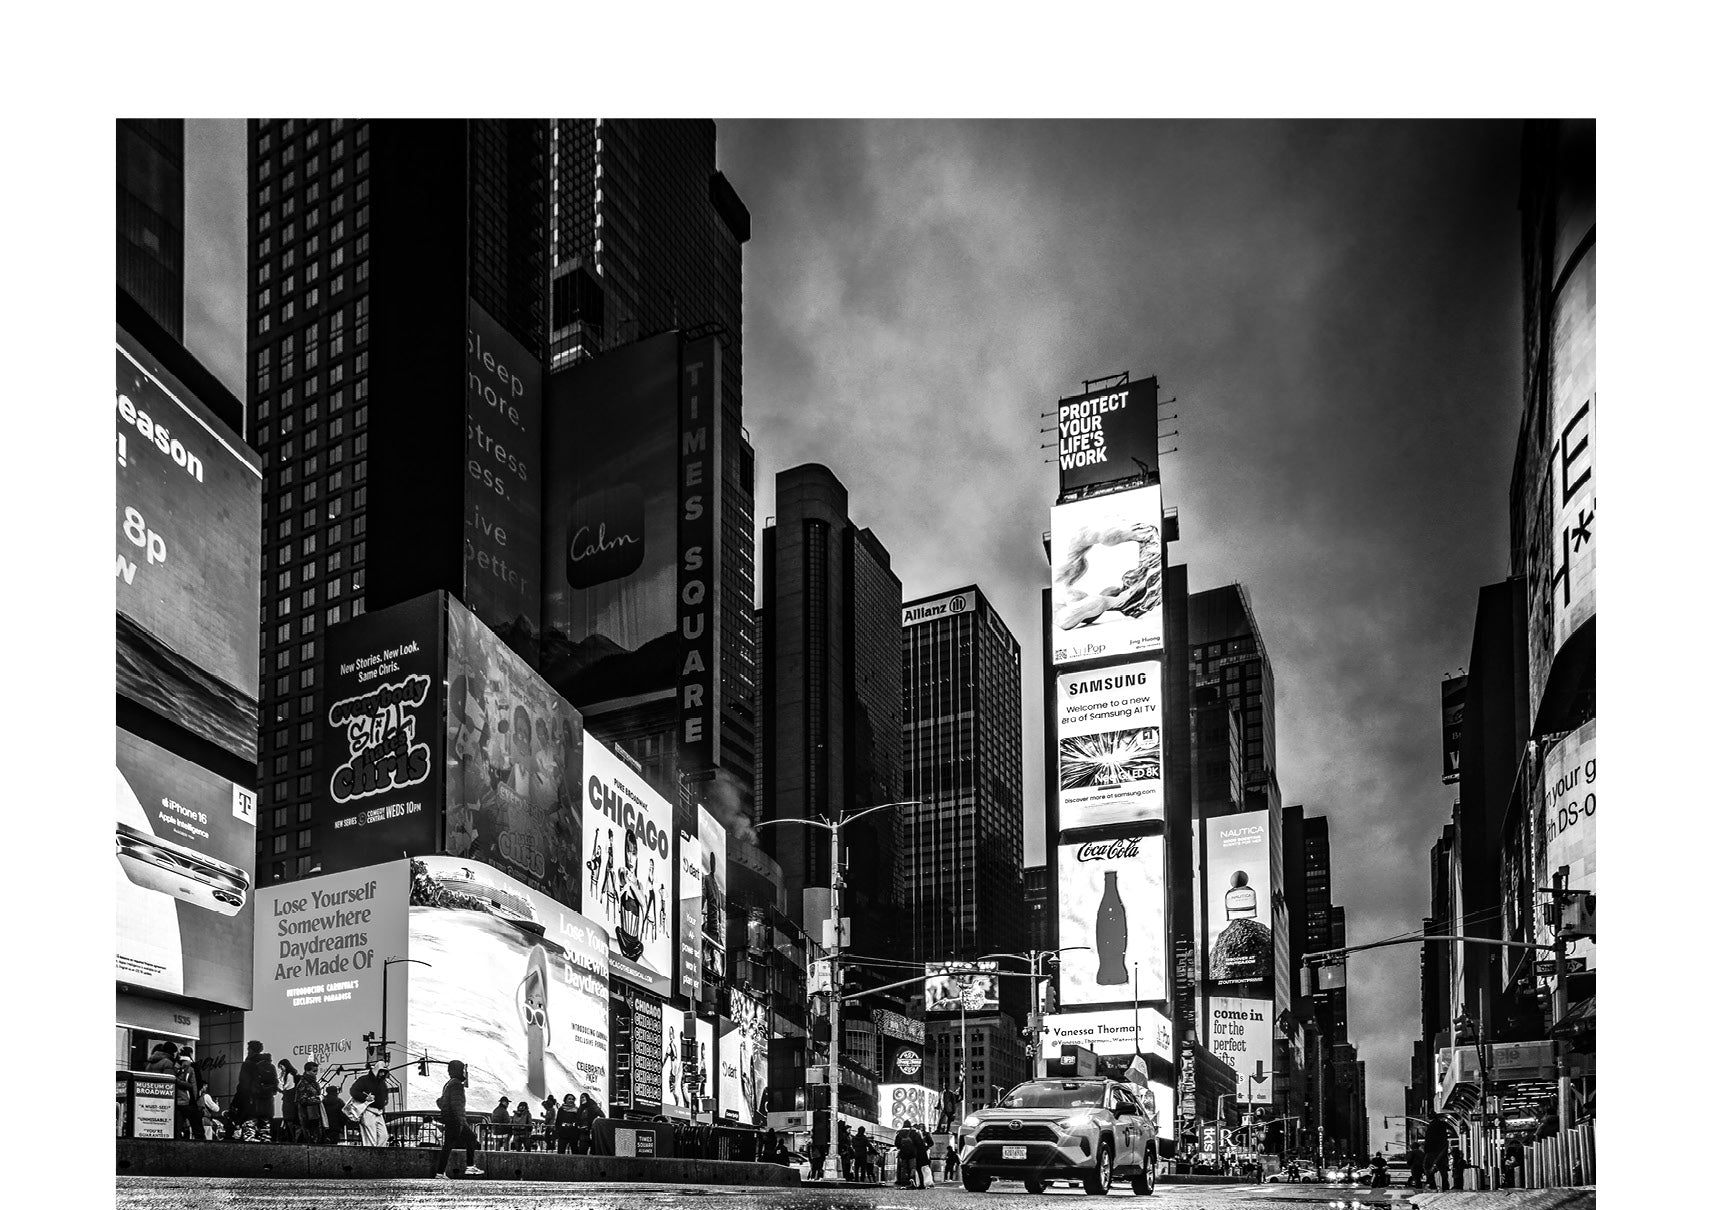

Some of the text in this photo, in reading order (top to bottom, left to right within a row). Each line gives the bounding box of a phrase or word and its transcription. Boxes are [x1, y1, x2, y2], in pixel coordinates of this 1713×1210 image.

[1060, 391, 1129, 422] PROTECT
[116, 393, 203, 482] eason
[1060, 415, 1102, 438] YOUR
[1060, 430, 1104, 455] LIFE'S
[1060, 446, 1107, 470] WORK
[570, 523, 639, 561] Calm
[681, 361, 707, 743] TIMES SQUARE
[904, 604, 947, 622] Allianz
[340, 640, 420, 675] New Stories. New Look.
[358, 661, 400, 683] Same Chris.
[1069, 673, 1146, 695] SAMSUNG
[1066, 702, 1108, 713] Welcome
[1078, 713, 1087, 722] of
[1090, 709, 1132, 721] Samsung
[1146, 767, 1159, 777] 8K
[614, 778, 625, 795] PURE
[1114, 789, 1156, 798] samsung.com
[1553, 766, 1581, 808] your
[169, 799, 208, 825] iPhone 16
[239, 791, 252, 816] T
[334, 820, 343, 829] NEW
[344, 817, 357, 827] SERIES
[386, 803, 405, 819] WEDS
[406, 801, 421, 814] 10PM
[158, 811, 177, 824] Apple
[176, 818, 209, 839] Intelligence
[588, 775, 669, 860] CHICAGO
[1220, 826, 1264, 838] NAUTICA
[274, 880, 377, 917] Lose Yourself
[277, 908, 371, 937] Somewhere
[279, 931, 368, 960] Daydreams
[275, 949, 374, 981] Are Made Of
[173, 1013, 191, 1026] 1535
[635, 998, 661, 1019] CHICAGO
[1214, 1009, 1263, 1021] come in
[1054, 1024, 1141, 1036] Vanessa Thorman
[1214, 1020, 1244, 1035] for the
[293, 1039, 351, 1056] CELEBRATION
[1214, 1038, 1246, 1053] perfect
[313, 1053, 331, 1065] KEY
[136, 1087, 174, 1095] BROADWAY
[1203, 1128, 1216, 1151] tkts
